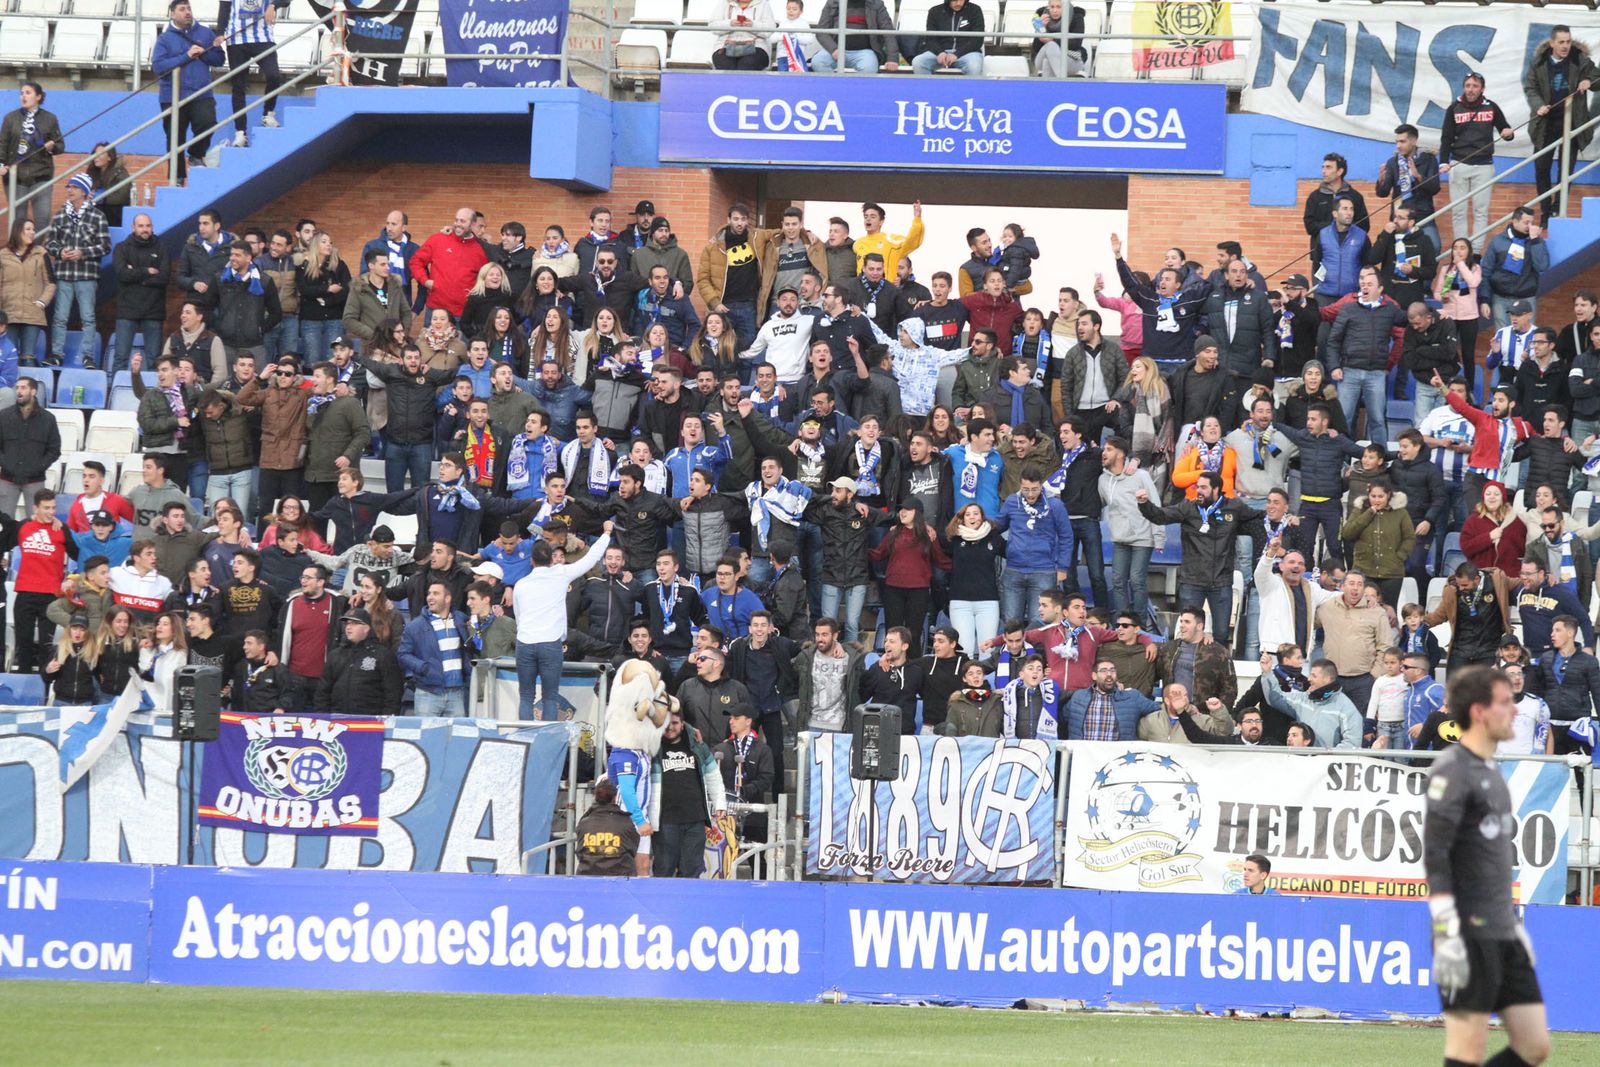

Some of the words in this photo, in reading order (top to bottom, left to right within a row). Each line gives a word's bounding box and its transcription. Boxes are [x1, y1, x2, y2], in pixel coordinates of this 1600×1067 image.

[459, 11, 559, 39] llamarnos
[1252, 7, 1497, 129] FANS
[707, 96, 846, 142] CEOSA
[893, 98, 1013, 135] Huelva
[1046, 102, 1186, 149] CEOSA
[922, 138, 955, 153] me
[964, 138, 1013, 158] pone
[22, 541, 57, 553] adidas
[240, 716, 349, 743] NEW
[1326, 762, 1430, 795] SECTO
[215, 785, 362, 828] ONUBAS
[814, 732, 963, 881] 1889
[1213, 799, 1557, 870] HELICÓSO
[819, 844, 883, 875] Forza
[886, 847, 956, 874] Recre
[1087, 850, 1121, 867] Sector
[1140, 866, 1166, 882] Gol
[1168, 861, 1192, 876] Sur
[0, 867, 58, 911] ÍN
[1268, 877, 1334, 895] DECANO
[1339, 879, 1376, 896] DEL
[1384, 879, 1430, 899] FÚTBO
[172, 895, 800, 975] Atraccioneslacinta.com
